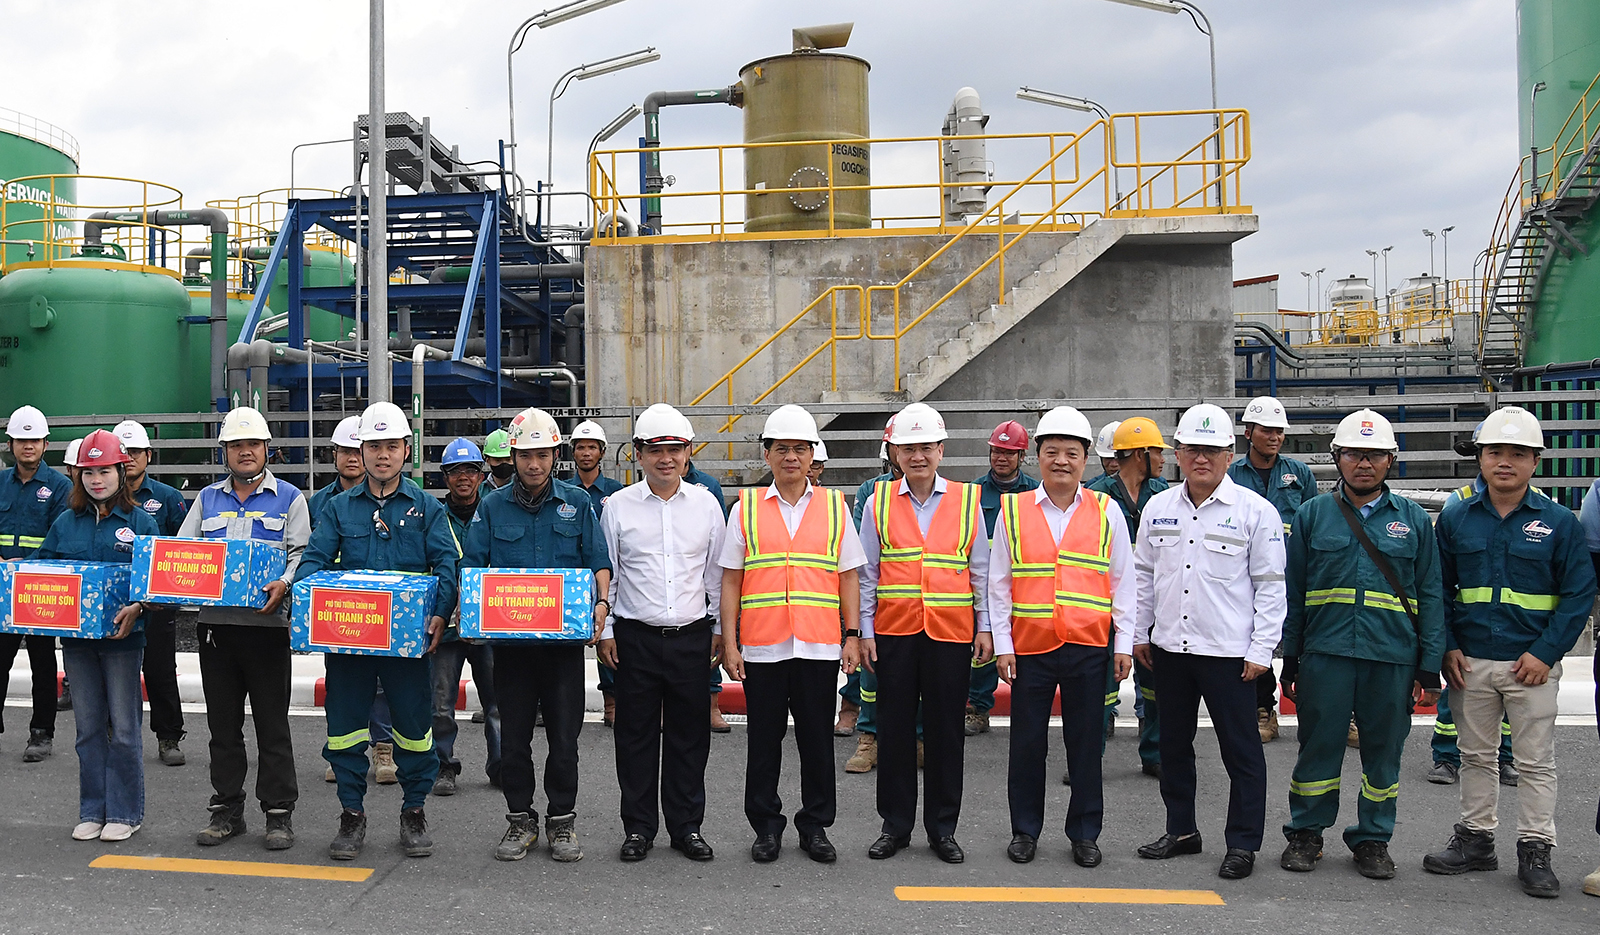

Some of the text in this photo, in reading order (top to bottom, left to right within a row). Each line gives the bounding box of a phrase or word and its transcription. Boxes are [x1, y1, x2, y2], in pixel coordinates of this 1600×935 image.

[157, 560, 218, 574] BÙI THANH SƠN
[176, 575, 196, 587] Tặng
[18, 592, 74, 606] BÙI THANH SƠN
[488, 595, 556, 607] BÙI THANH SƠN
[36, 607, 55, 618] Tặng
[318, 609, 384, 624] BÙI THANH SƠN
[510, 610, 532, 621] Tặng
[339, 625, 360, 637] Tặng
